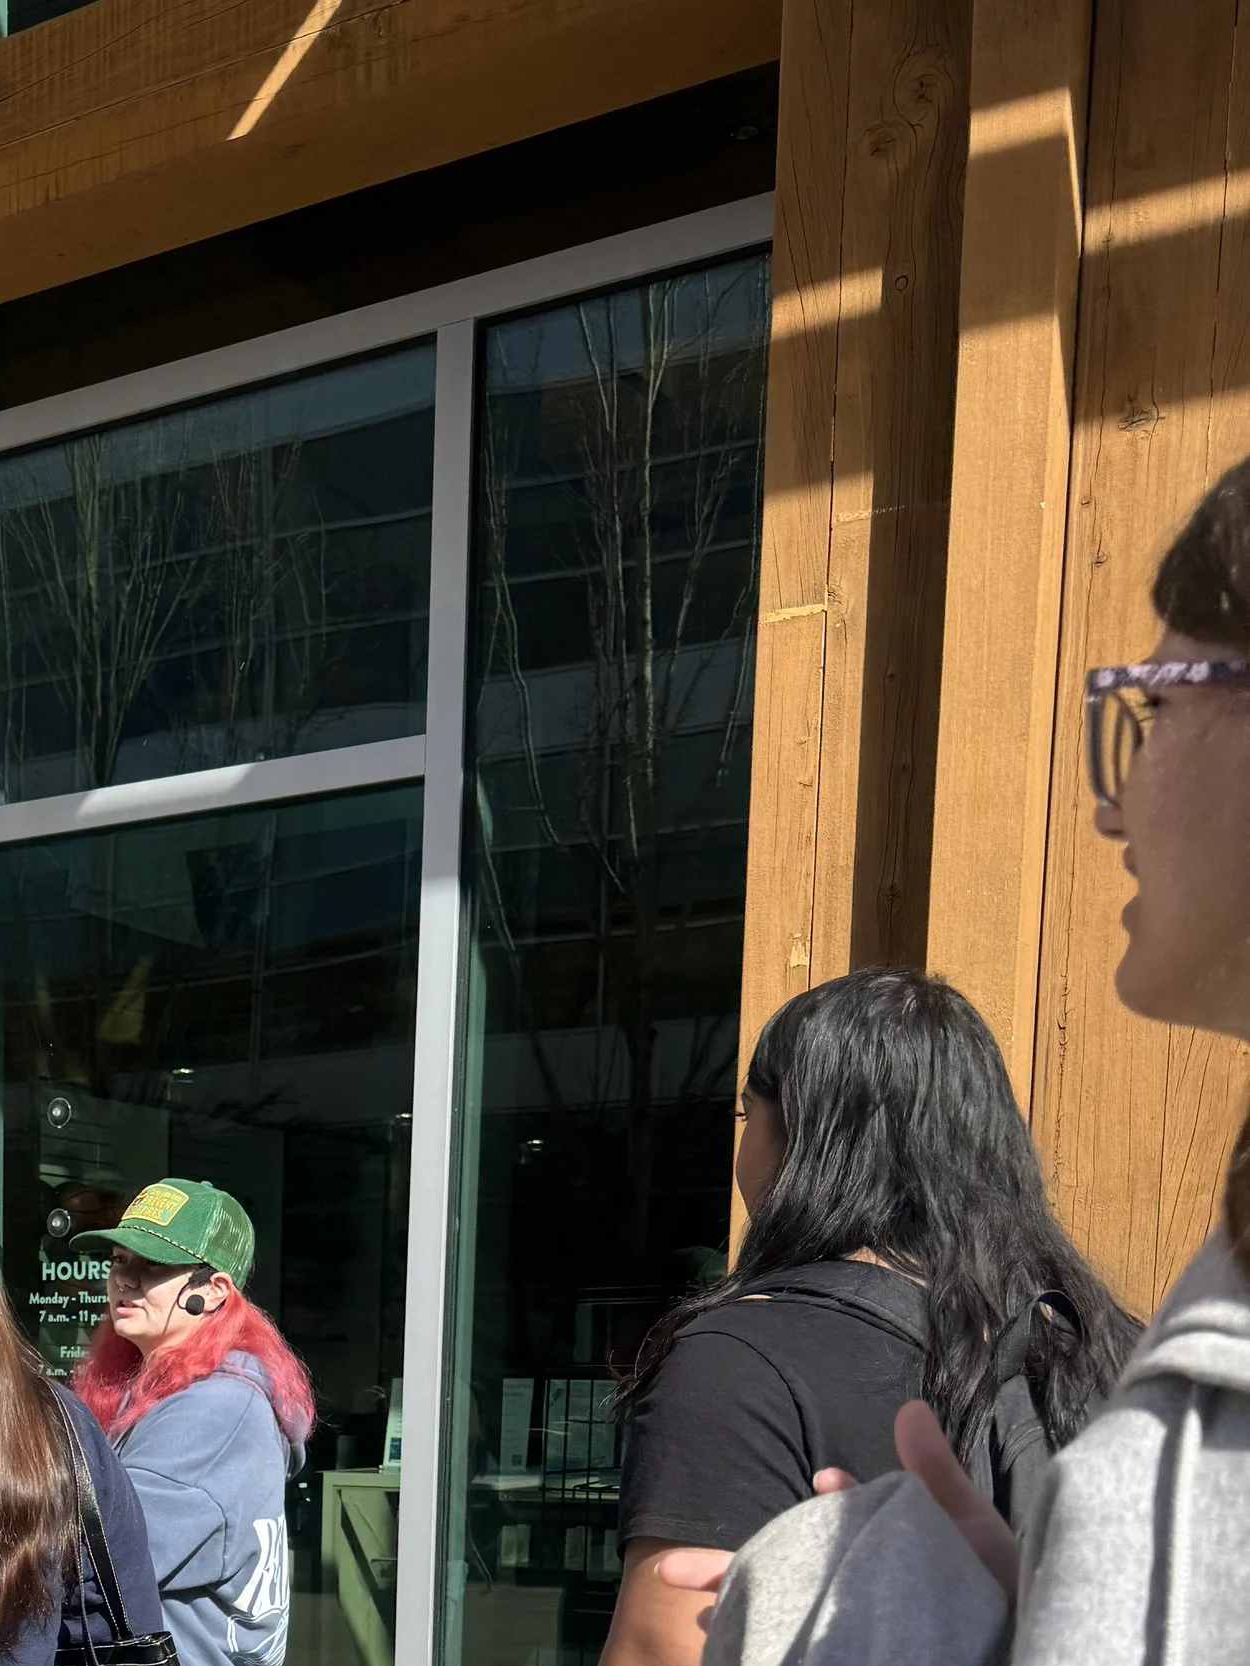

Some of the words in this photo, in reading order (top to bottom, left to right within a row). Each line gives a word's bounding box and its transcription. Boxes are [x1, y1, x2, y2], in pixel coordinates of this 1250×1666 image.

[42, 1261, 111, 1280] HOURS
[30, 1292, 69, 1308] Monday
[39, 1311, 46, 1322] 7
[48, 1314, 69, 1322] a.m.
[79, 1310, 88, 1322] 11
[46, 1368, 67, 1376] a.m.
